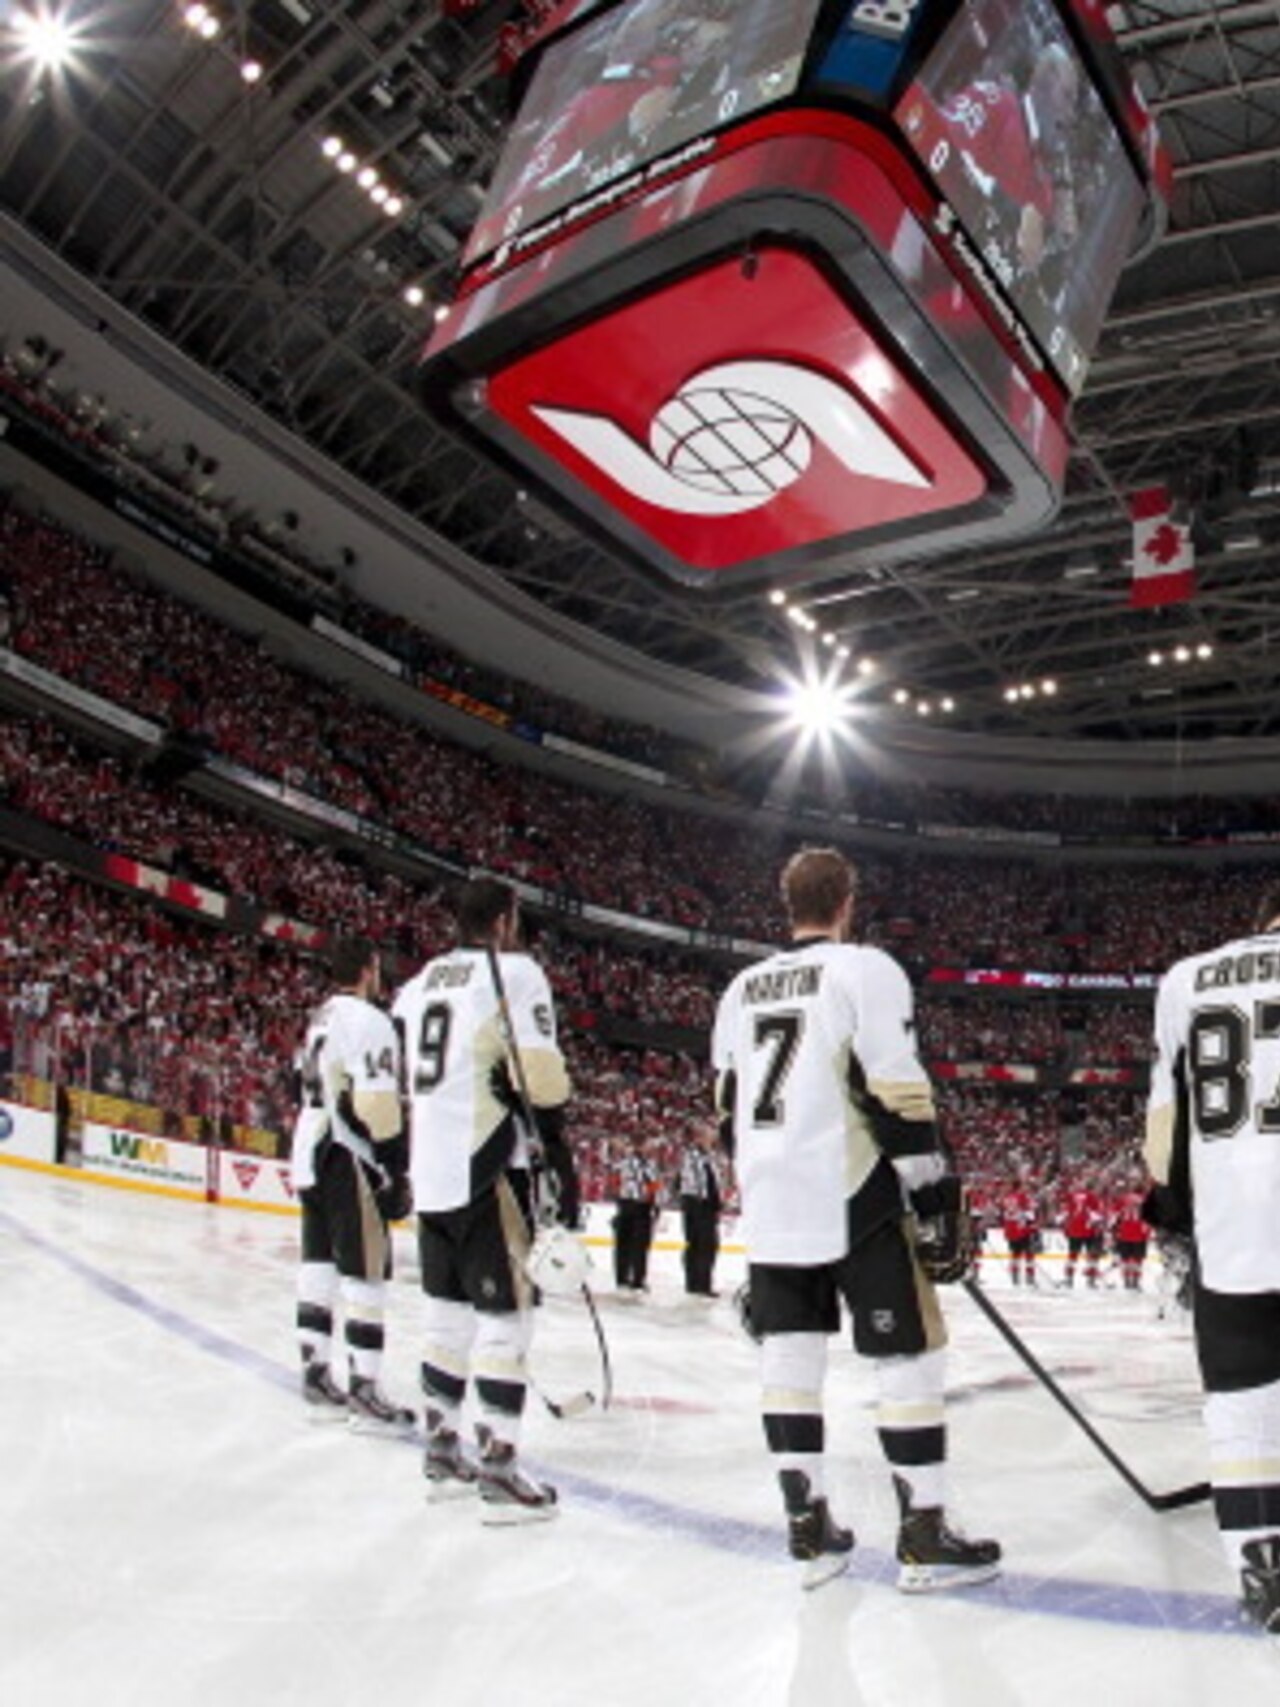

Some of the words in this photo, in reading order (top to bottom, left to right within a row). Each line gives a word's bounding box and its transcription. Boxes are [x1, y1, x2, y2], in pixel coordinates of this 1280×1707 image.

[364, 1047, 394, 1079] 14
[414, 1000, 453, 1096] 9
[752, 1008, 806, 1129] 7
